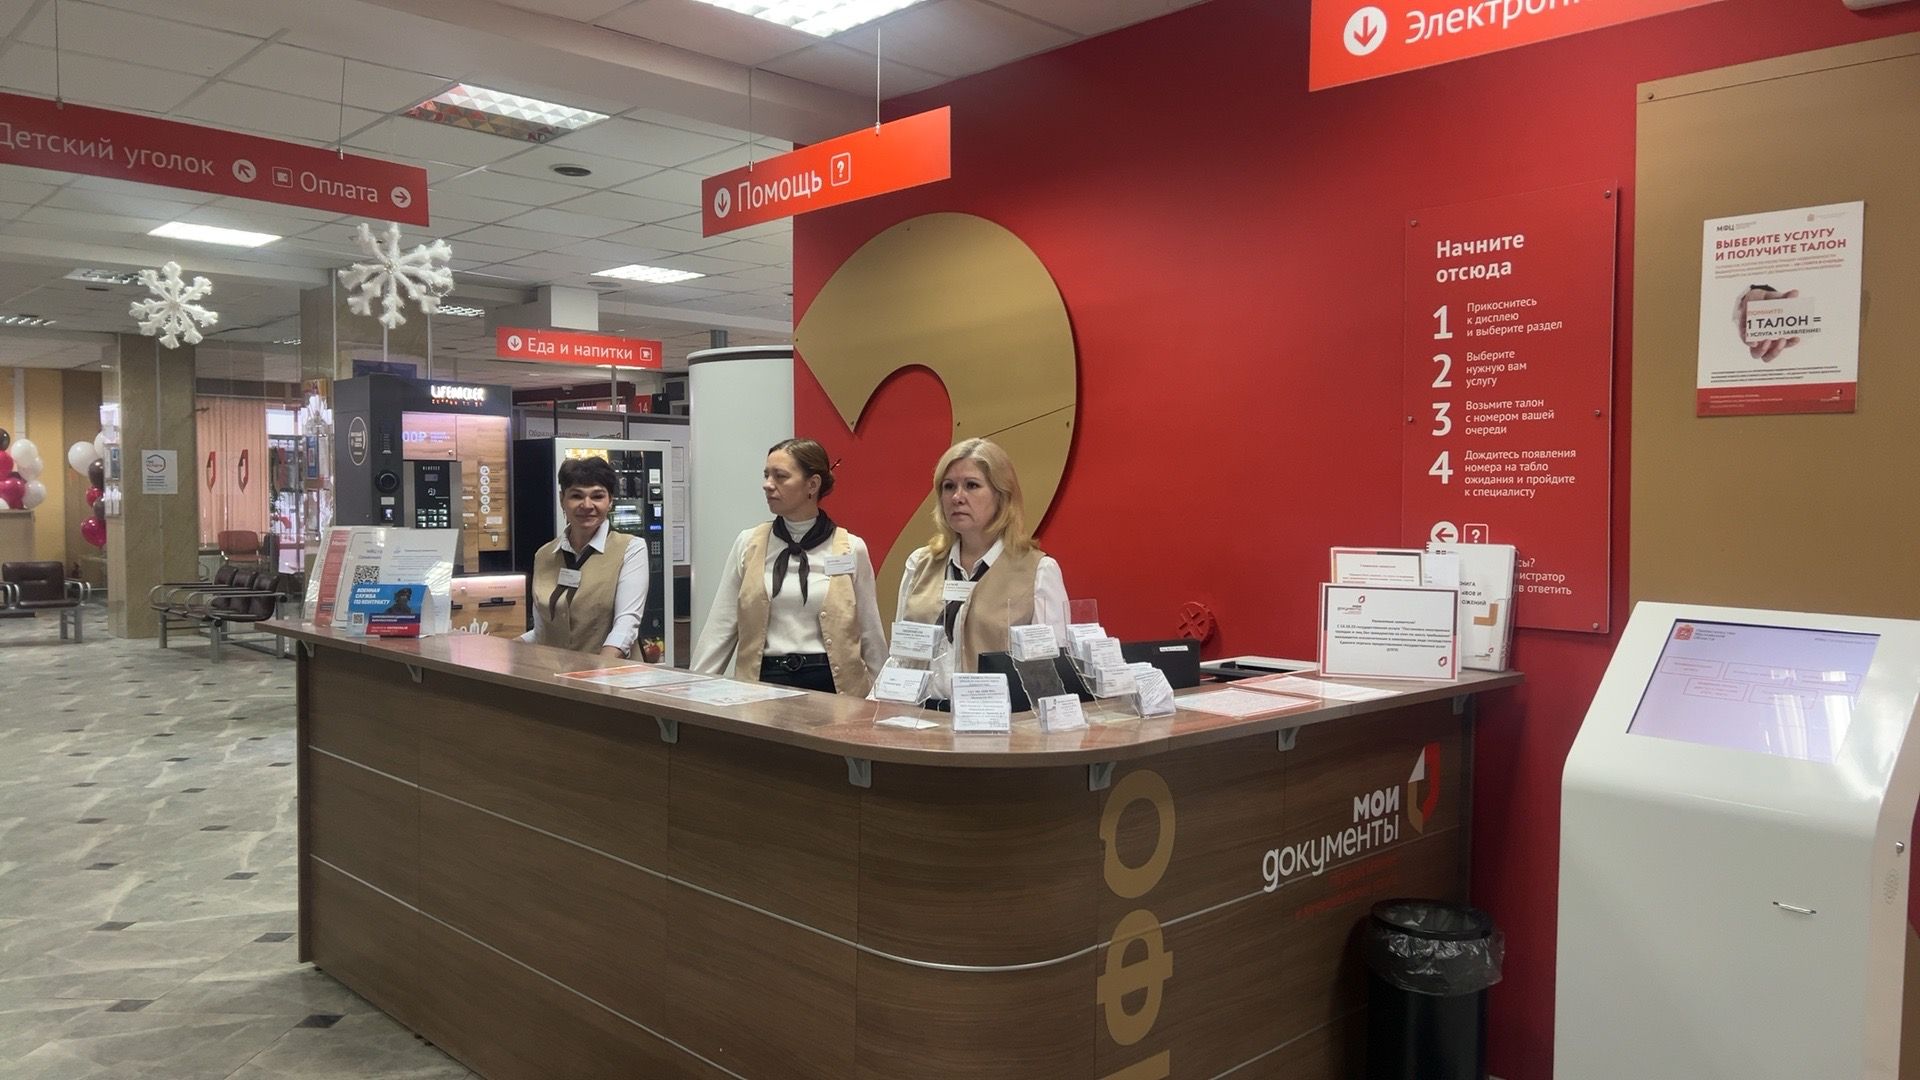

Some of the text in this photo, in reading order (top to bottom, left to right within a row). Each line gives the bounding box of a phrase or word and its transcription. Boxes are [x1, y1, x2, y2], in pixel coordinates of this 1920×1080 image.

[1404, 0, 1580, 44] Электро
[0, 122, 215, 176] Детский уголок
[301, 171, 379, 203] Оплата
[738, 170, 823, 212] Помощь
[1436, 234, 1525, 259] Начните
[1716, 228, 1835, 250] ВЫБЕРИТЕ УСЛУГУ
[1715, 239, 1847, 262] И ПОЛУЧИТЕ ТАЛОН
[1436, 261, 1512, 283] отсюда
[1467, 298, 1537, 313] Прикоснитесь
[1433, 305, 1454, 340] 1
[1467, 312, 1519, 326] к дисплею
[1756, 315, 1809, 329] ТАЛОН
[1467, 320, 1563, 338] и выберите раздел
[528, 337, 633, 360] Еда и напитки
[1466, 350, 1515, 362] Выберите
[1432, 354, 1453, 388] 2
[1466, 362, 1527, 375] нужную вам
[1466, 376, 1497, 388] услугу
[1466, 399, 1544, 411] Возьмите талон
[1432, 402, 1452, 437] 3
[1465, 409, 1555, 424] с номером вашей
[1465, 426, 1507, 437] очереди
[1464, 449, 1576, 461] Дождитесь появления
[1428, 450, 1454, 485] 4
[1464, 464, 1502, 473] номера
[1519, 462, 1549, 472] табло
[1464, 474, 1575, 486] ожидания и пройдите
[1473, 488, 1536, 499] специалисту
[1527, 585, 1572, 596] ответить
[1262, 814, 1400, 893] документы
